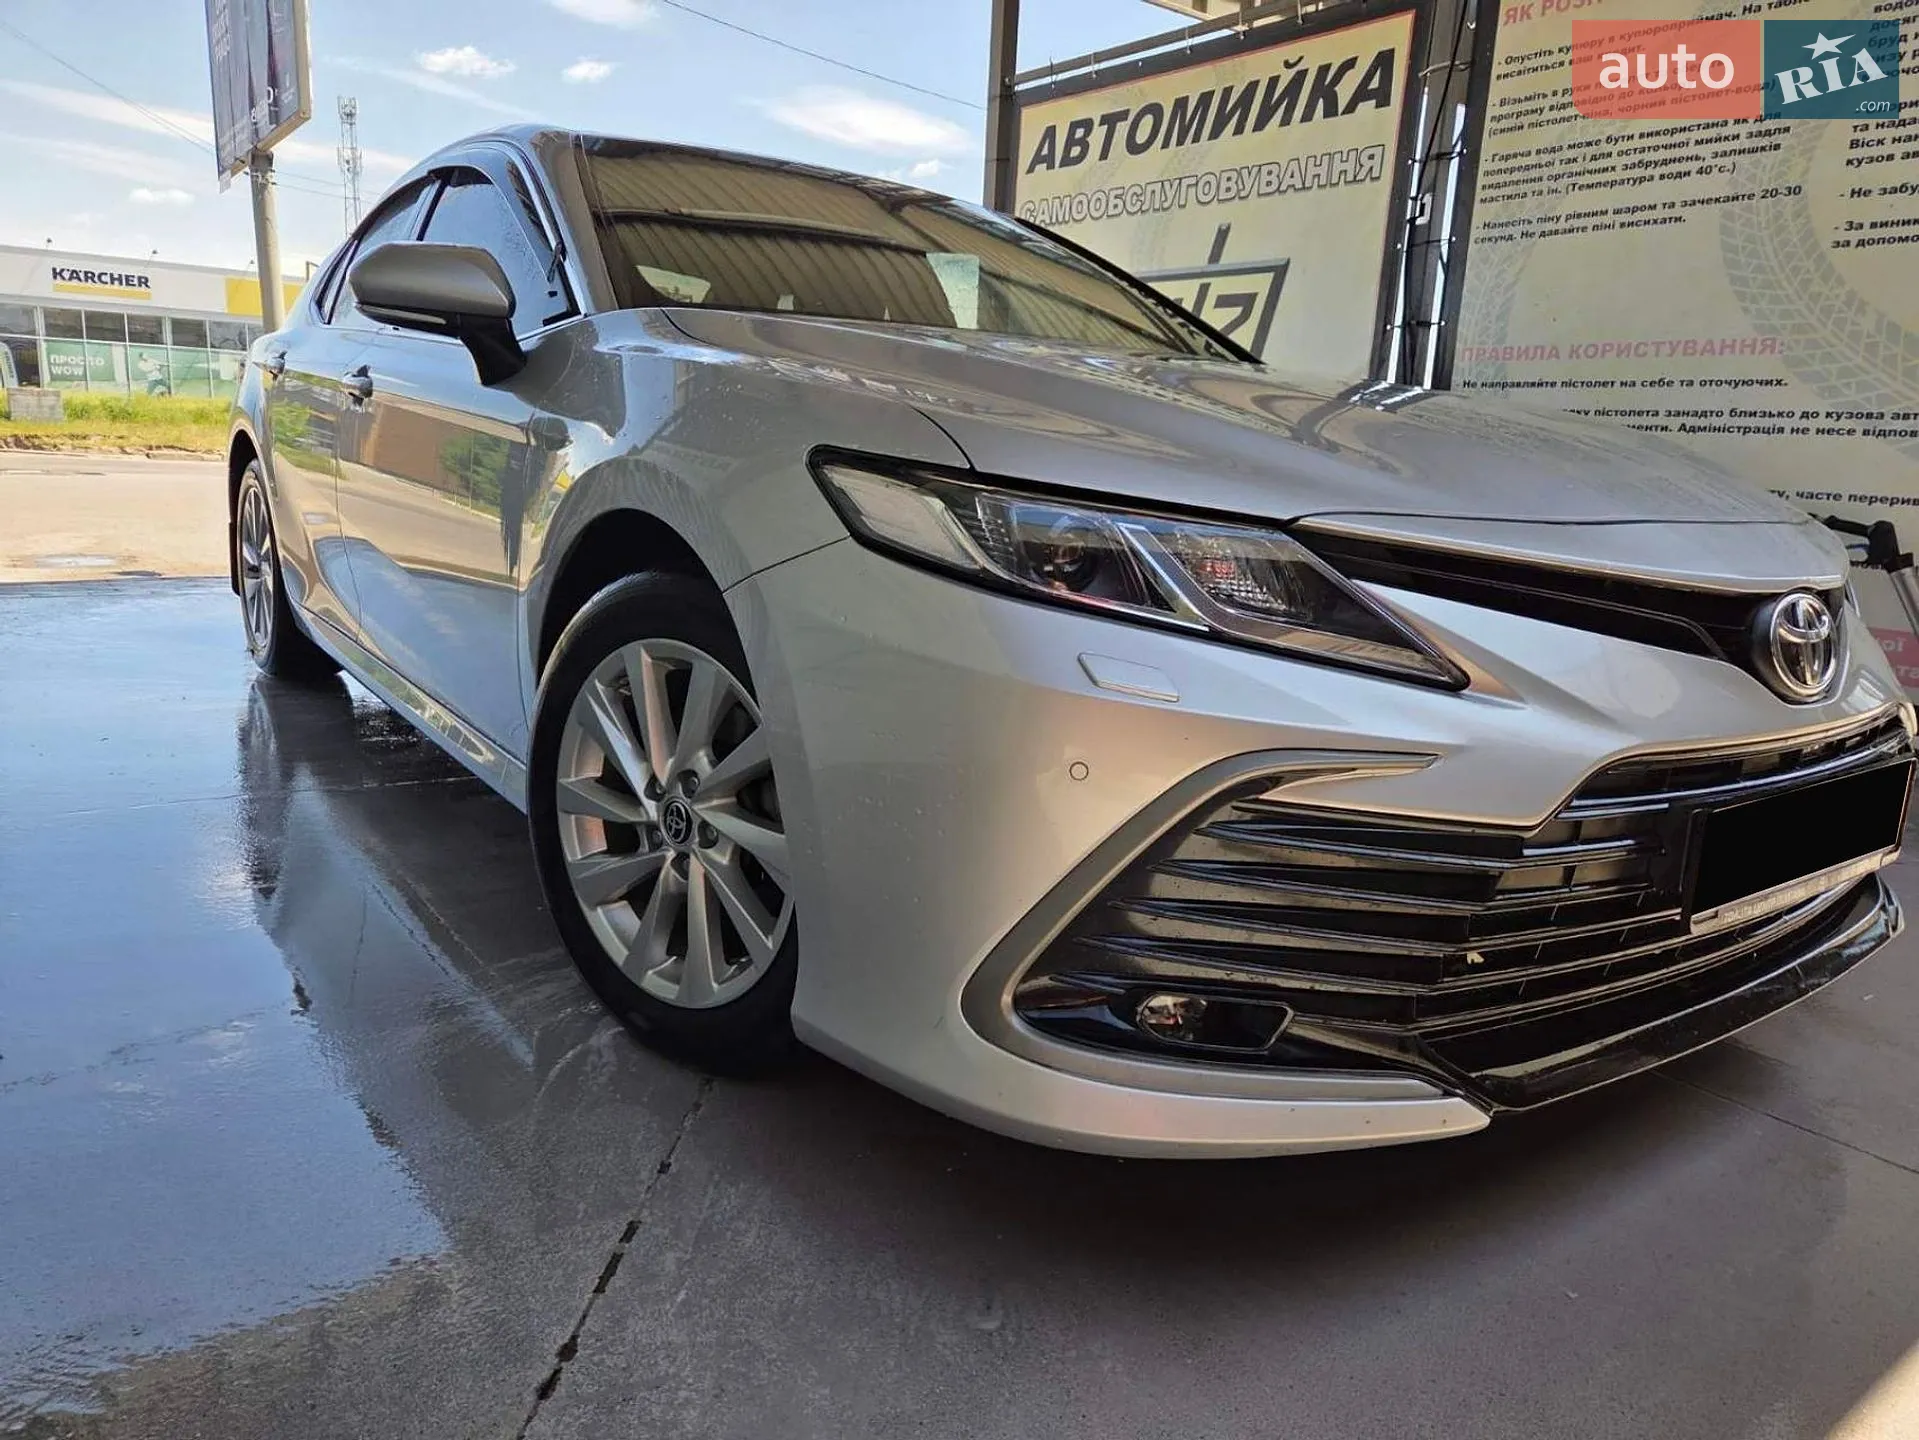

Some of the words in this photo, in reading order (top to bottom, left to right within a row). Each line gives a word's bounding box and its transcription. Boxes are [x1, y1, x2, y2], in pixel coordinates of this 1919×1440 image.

[1503, 3, 1534, 26] ЯК
[1742, 3, 1762, 15] На
[1025, 48, 1395, 175] АВТОМИЙКА
[1605, 134, 1635, 147] бути
[1638, 118, 1728, 140] використана
[1559, 156, 1579, 167] так
[1590, 150, 1613, 164] для
[1694, 132, 1741, 148] мийки
[1746, 126, 1791, 140] задля
[1711, 141, 1781, 160] залишків
[1849, 137, 1886, 149] Віск
[1845, 153, 1895, 168] кузов
[1659, 169, 1692, 182] води
[1019, 144, 1384, 226] САМООБСЛУГОВУВАННЯ
[1850, 187, 1872, 199] Не
[1612, 201, 1657, 217] шаром
[1662, 200, 1675, 210] та
[1680, 190, 1756, 208] зачекайте
[1760, 184, 1802, 200] 20-30
[1520, 229, 1536, 241] Не
[1619, 215, 1686, 229] висихати.
[1844, 220, 1864, 232] За
[1831, 239, 1851, 250] за
[52, 266, 151, 289] KÄRCHER
[1461, 344, 1561, 363] ПРАВИЛА
[1568, 336, 1785, 360] КОРИСТУВАННЯ:
[1462, 379, 1477, 390] Не
[1480, 378, 1557, 392] направляйте
[1561, 377, 1616, 390] пістолет
[1620, 379, 1637, 389] на
[1641, 376, 1675, 389] себе
[1679, 379, 1695, 388] та
[1699, 377, 1788, 391] оточуючих.
[1594, 406, 1660, 418] пістолета
[1664, 409, 1725, 420] занадто
[1729, 406, 1796, 420] близько
[1799, 410, 1820, 421] до
[1825, 410, 1885, 422] кузова
[1677, 421, 1785, 437] Адміністрація
[1790, 427, 1810, 436] не
[1815, 427, 1857, 437] несе
[1795, 489, 1843, 501] часте
